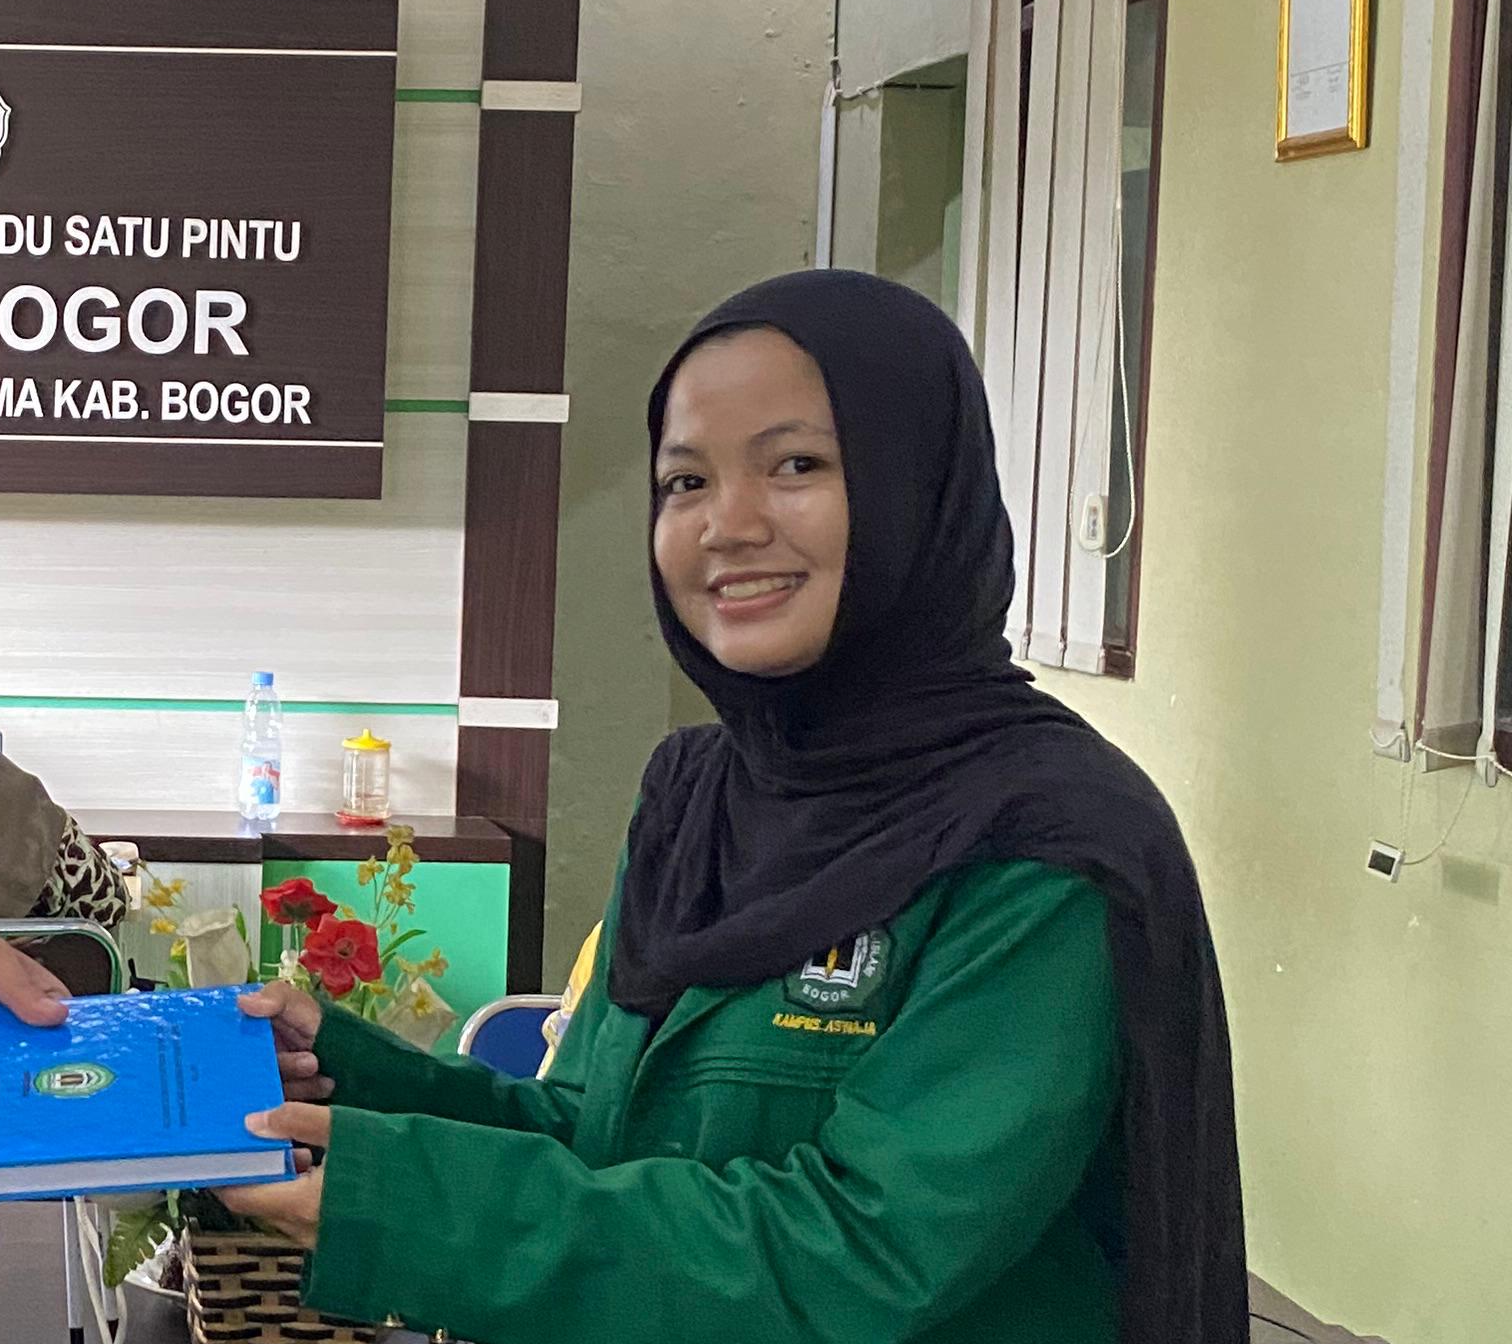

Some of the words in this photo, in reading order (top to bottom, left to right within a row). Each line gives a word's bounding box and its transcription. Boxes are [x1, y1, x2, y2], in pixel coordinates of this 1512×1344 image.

[64, 214, 170, 258] SATU
[182, 218, 301, 262] PINTU
[53, 379, 149, 421] KAB.
[161, 381, 312, 425] BOGOR
[802, 983, 850, 1002] BOGOR
